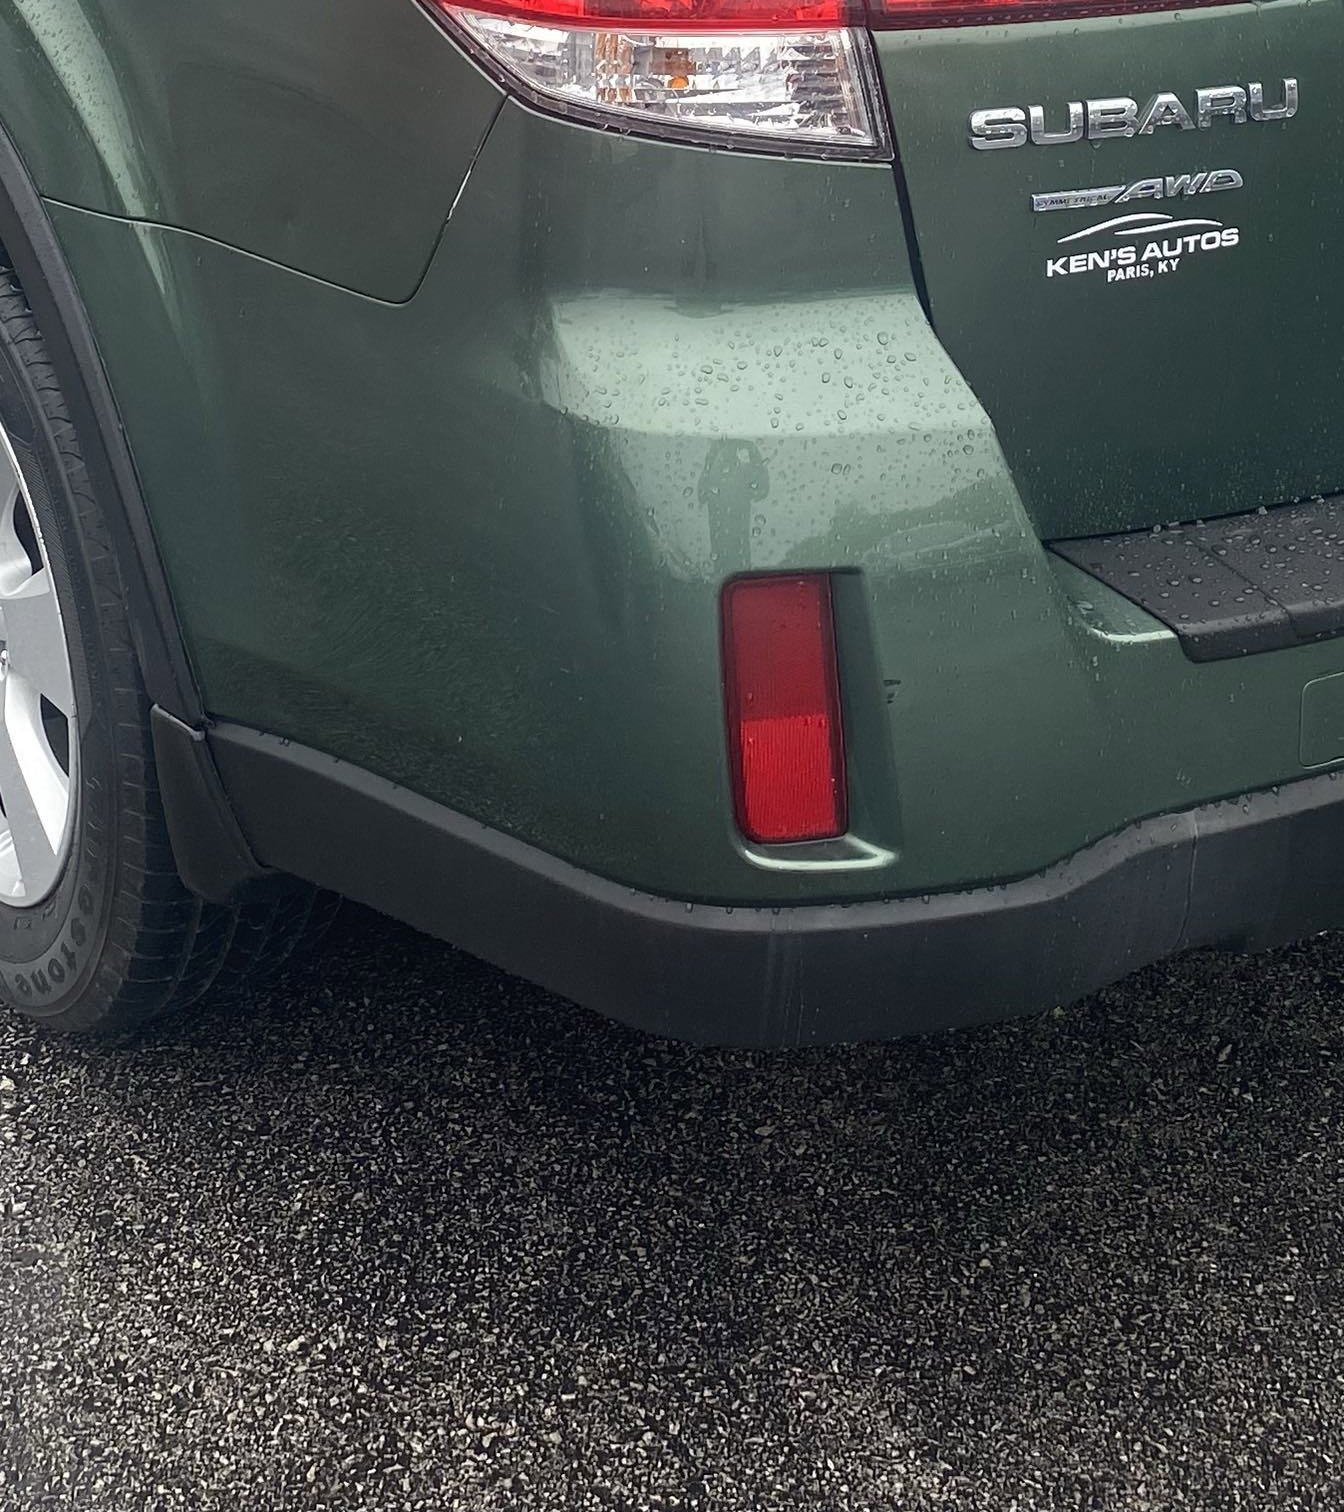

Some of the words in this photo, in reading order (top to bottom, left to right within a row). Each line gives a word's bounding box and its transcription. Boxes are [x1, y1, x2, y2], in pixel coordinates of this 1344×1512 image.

[968, 77, 1299, 151] SUBARU
[1112, 169, 1244, 204] AWD
[1046, 247, 1137, 277] KEN'S
[1140, 227, 1239, 258] AUTOS
[1107, 263, 1155, 283] PARIS,
[1157, 257, 1181, 274] KY
